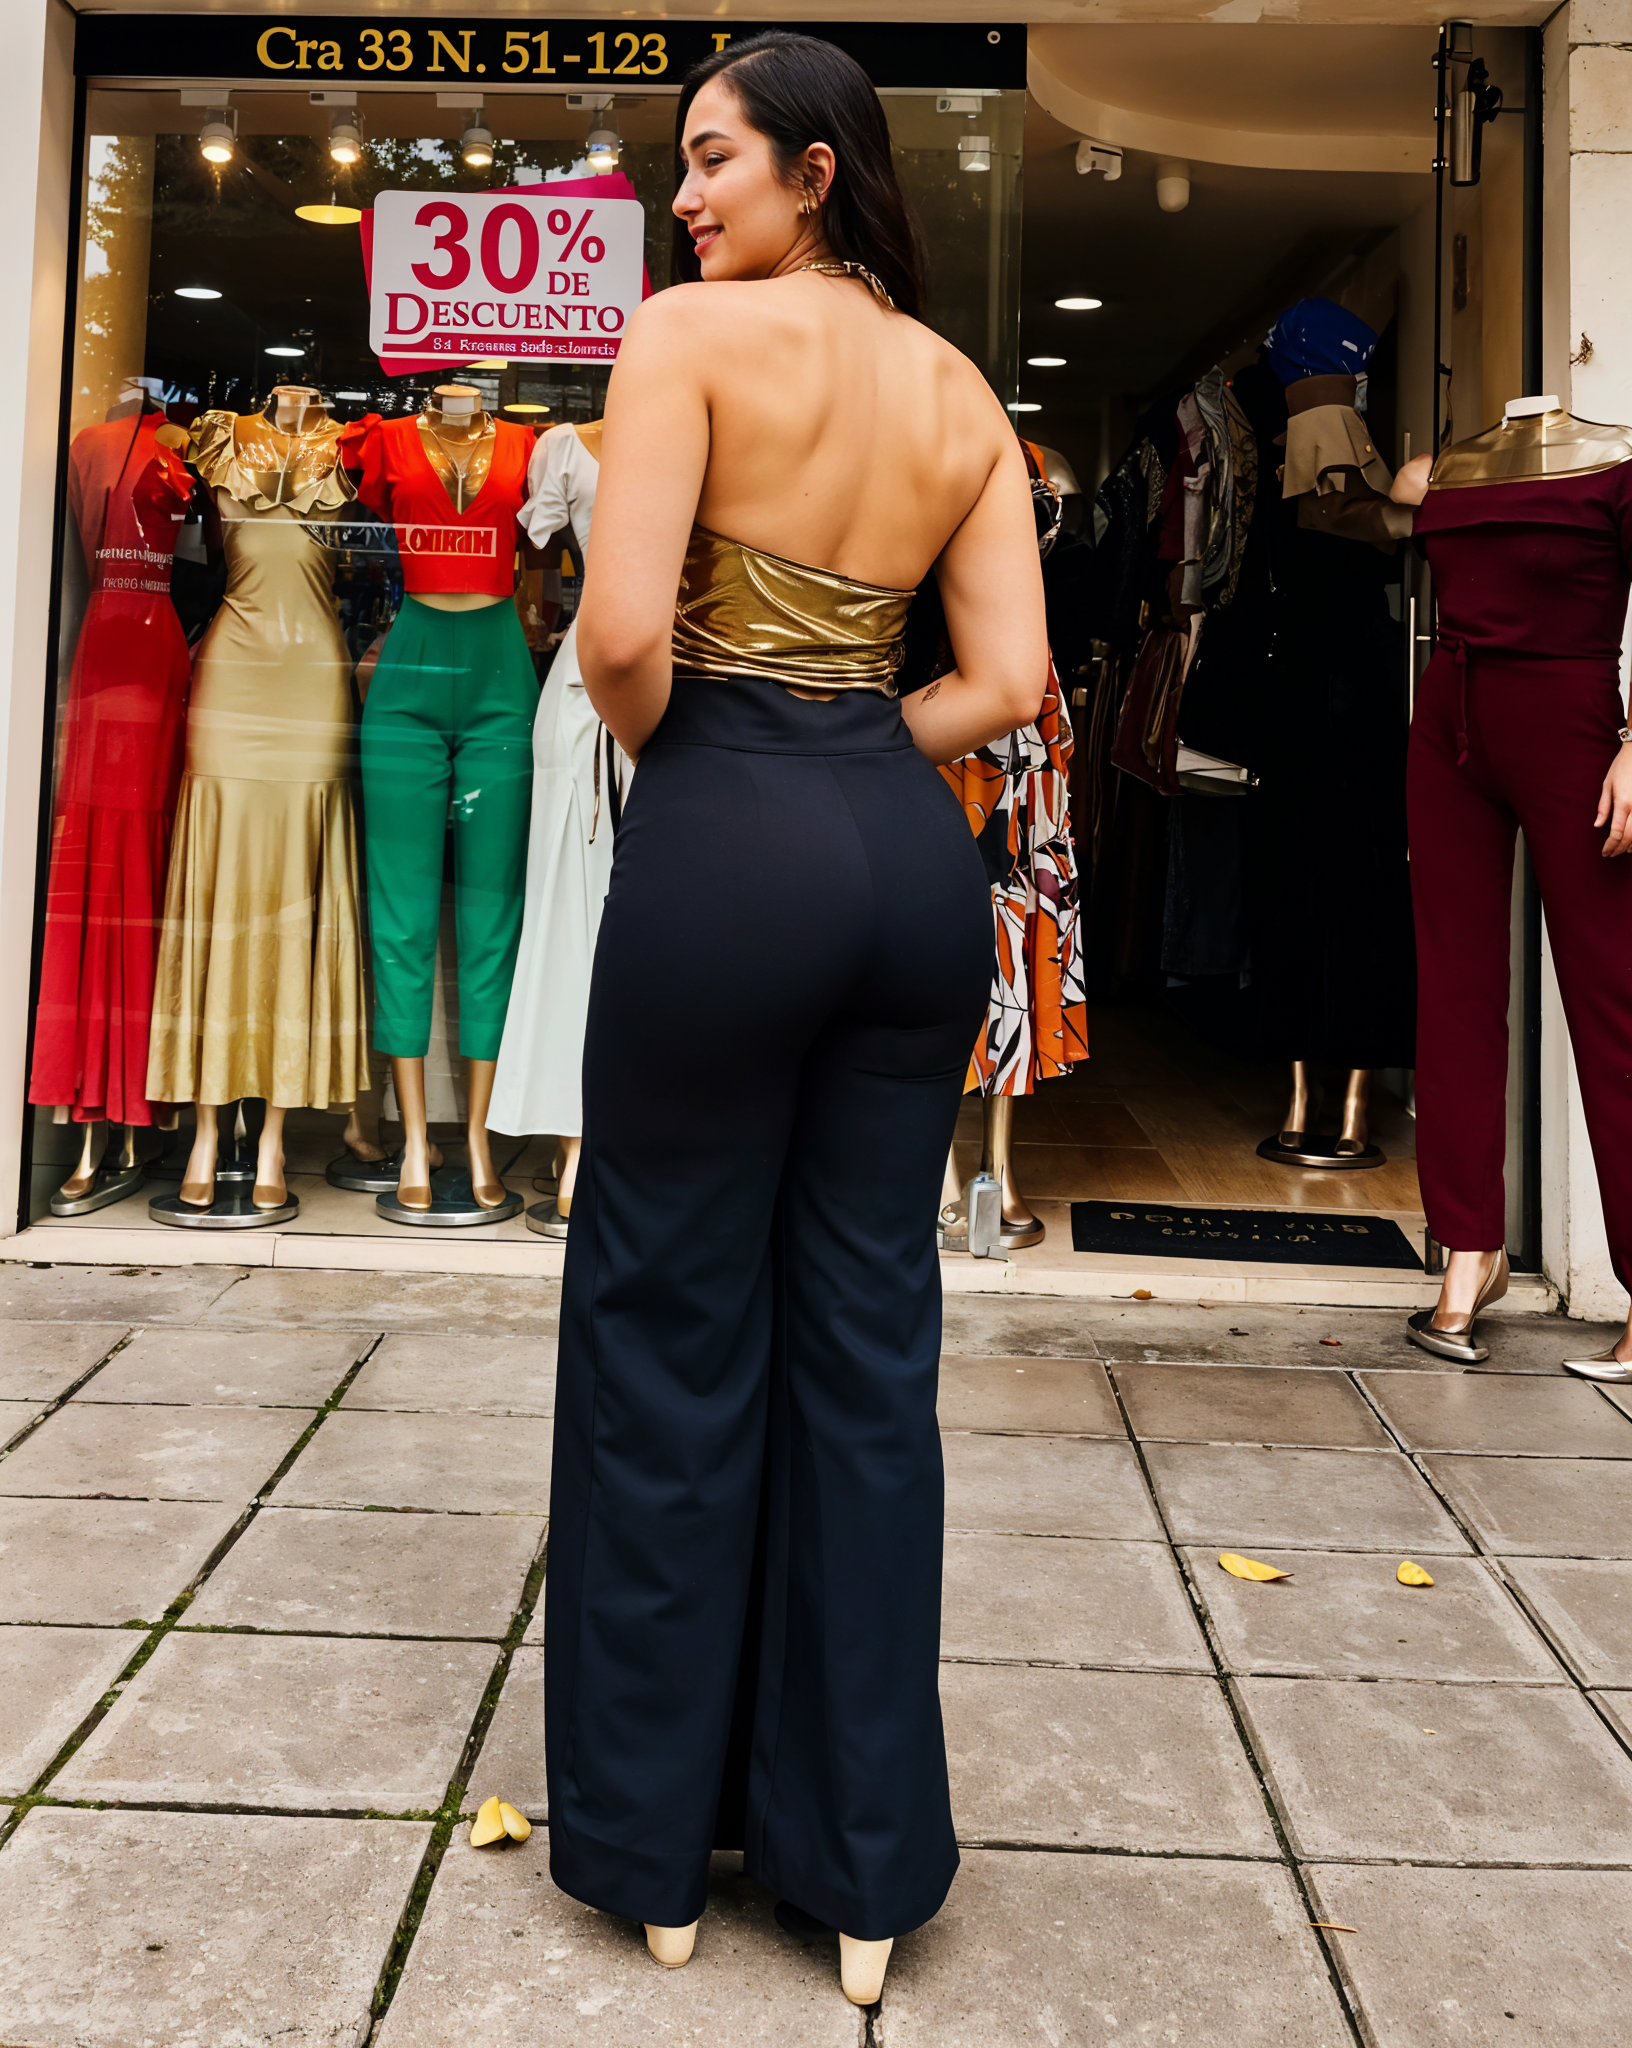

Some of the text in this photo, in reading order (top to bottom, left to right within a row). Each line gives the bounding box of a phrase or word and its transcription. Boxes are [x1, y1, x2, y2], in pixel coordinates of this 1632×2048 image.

[256, 26, 344, 71] Cra
[357, 28, 414, 72] 33
[426, 30, 487, 74] N.
[501, 31, 669, 75] 51-123
[410, 201, 606, 294] 30%
[546, 271, 590, 296] DE
[384, 292, 625, 335] DESCUENTO
